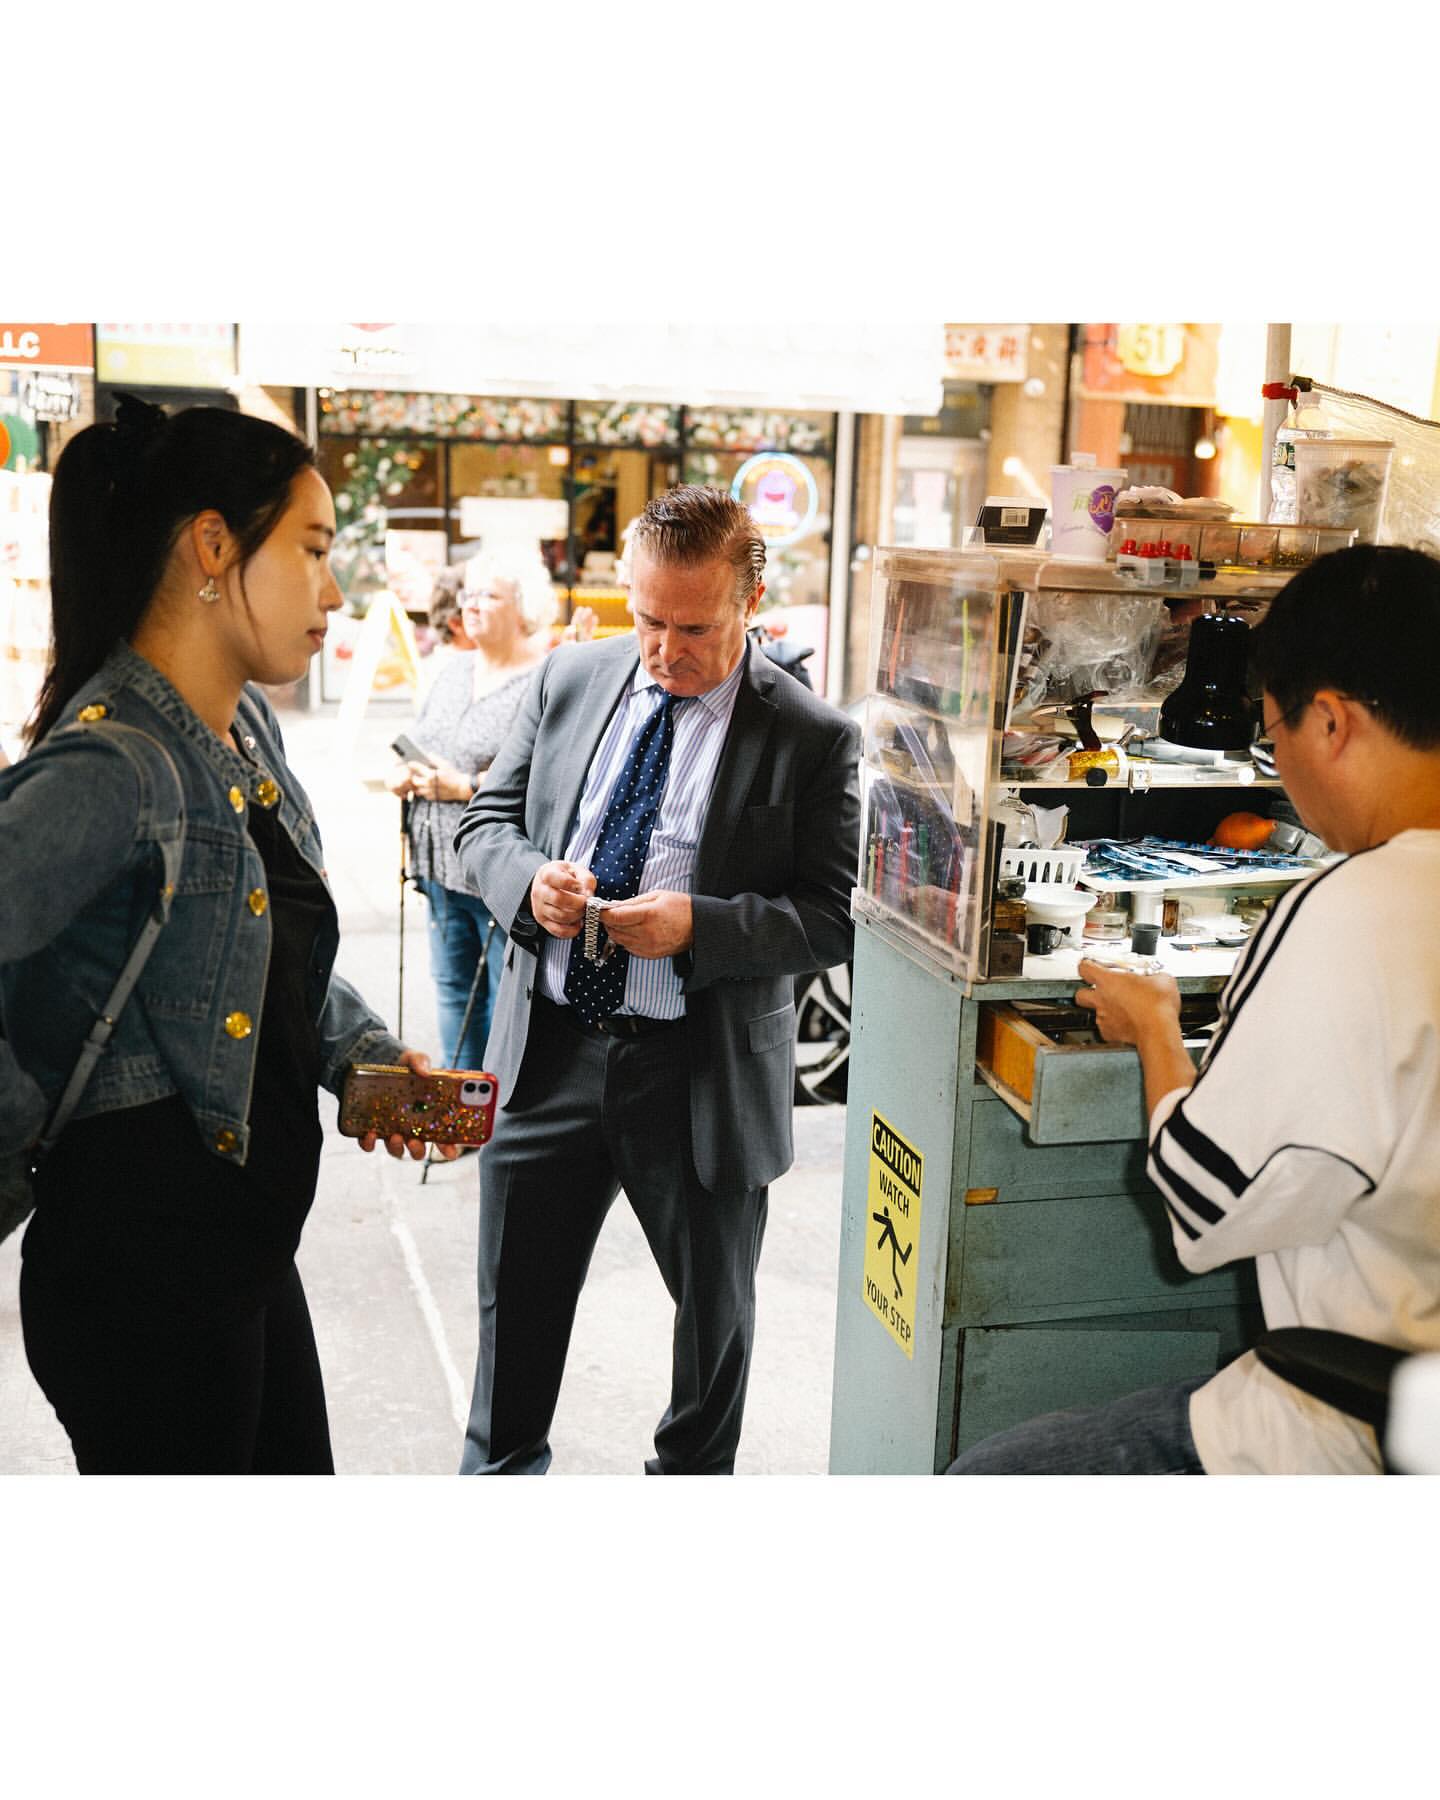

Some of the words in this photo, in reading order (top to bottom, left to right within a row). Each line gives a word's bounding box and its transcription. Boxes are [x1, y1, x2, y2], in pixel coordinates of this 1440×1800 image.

[0, 331, 40, 358] LC
[873, 1122, 920, 1190] CAUTION
[879, 1169, 909, 1218] WATCH
[866, 1274, 889, 1318] YOUR
[890, 1305, 911, 1343] STEP
